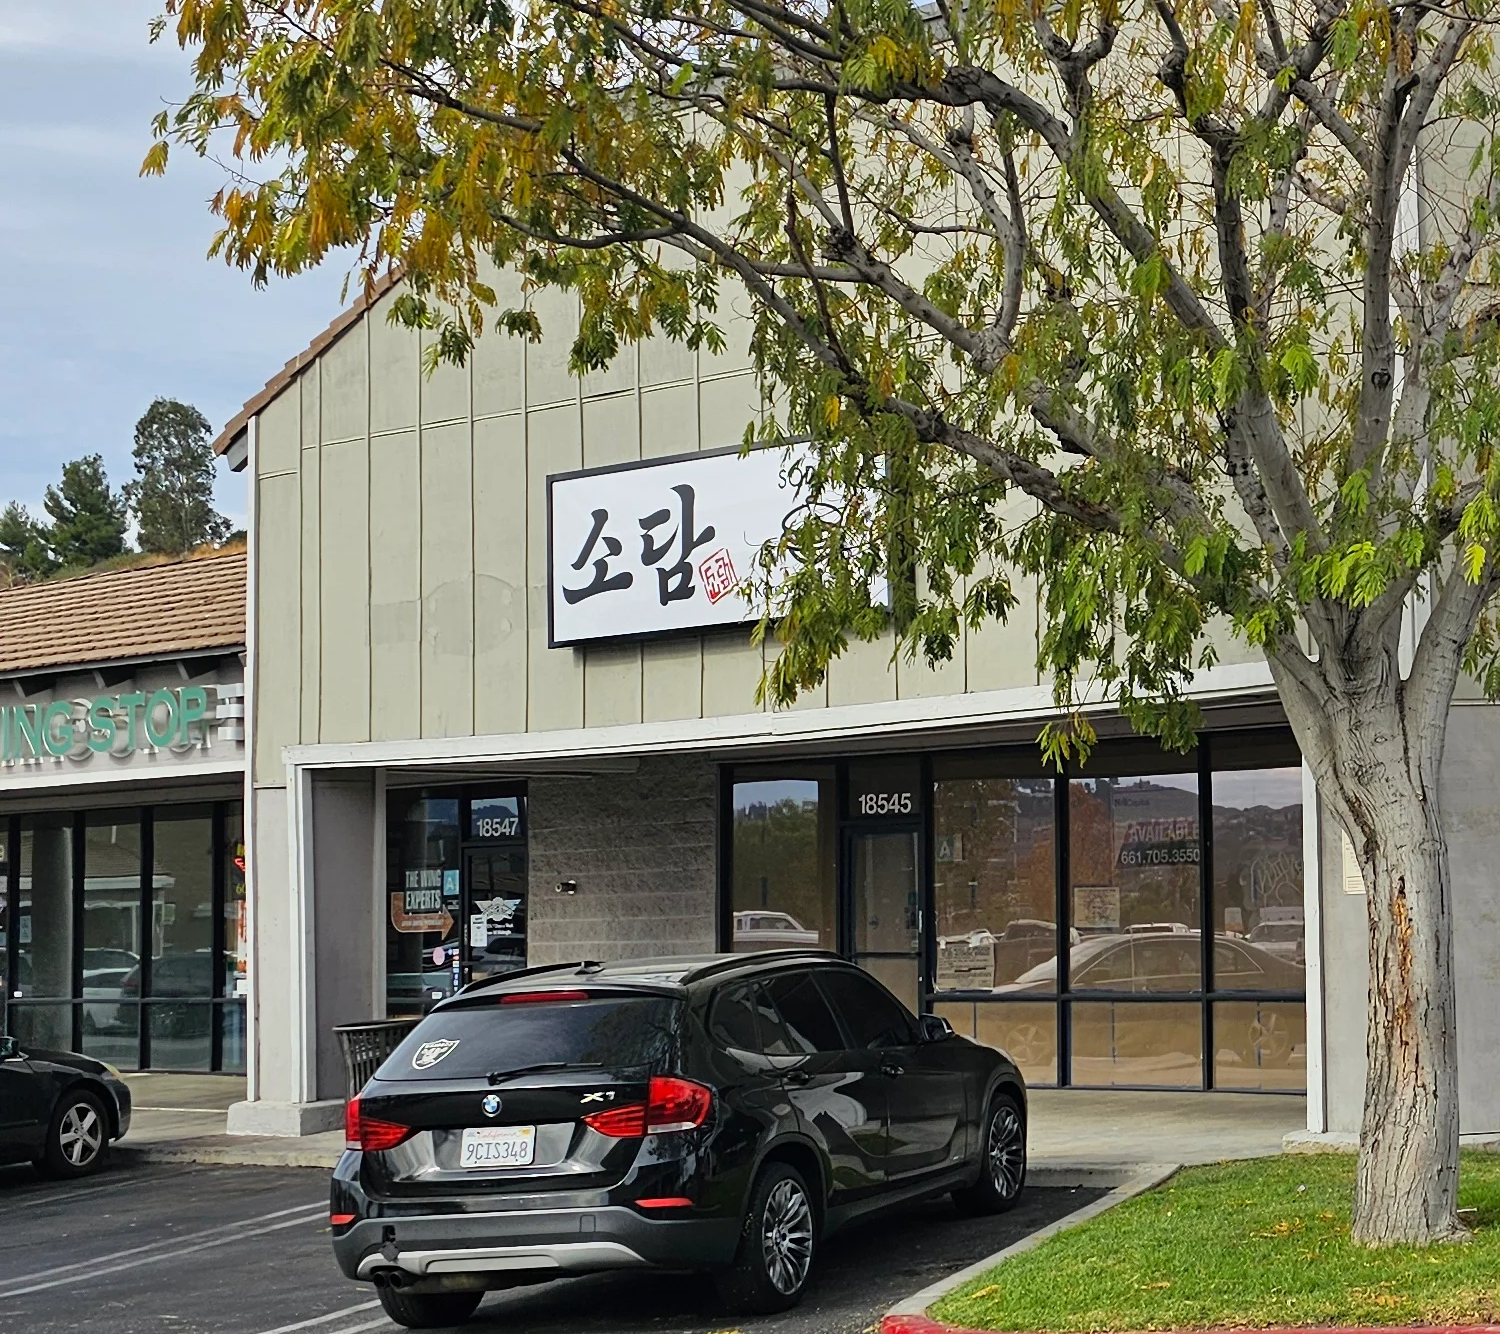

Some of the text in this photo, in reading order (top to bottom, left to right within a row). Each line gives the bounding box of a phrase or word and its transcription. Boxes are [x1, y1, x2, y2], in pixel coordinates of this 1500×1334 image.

[561, 483, 716, 607] 소담
[87, 686, 207, 753] STOP
[858, 792, 912, 815] 18545
[476, 817, 519, 837] 18547
[1128, 819, 1199, 843] AVAILABLE
[939, 840, 951, 858] A
[1120, 848, 1201, 865] 661.705.3550
[405, 869, 442, 888] THE WING
[446, 876, 455, 891] A
[405, 889, 442, 910] EXPERTS
[580, 1090, 616, 1104] X1
[466, 1141, 528, 1161] 9CIS348
